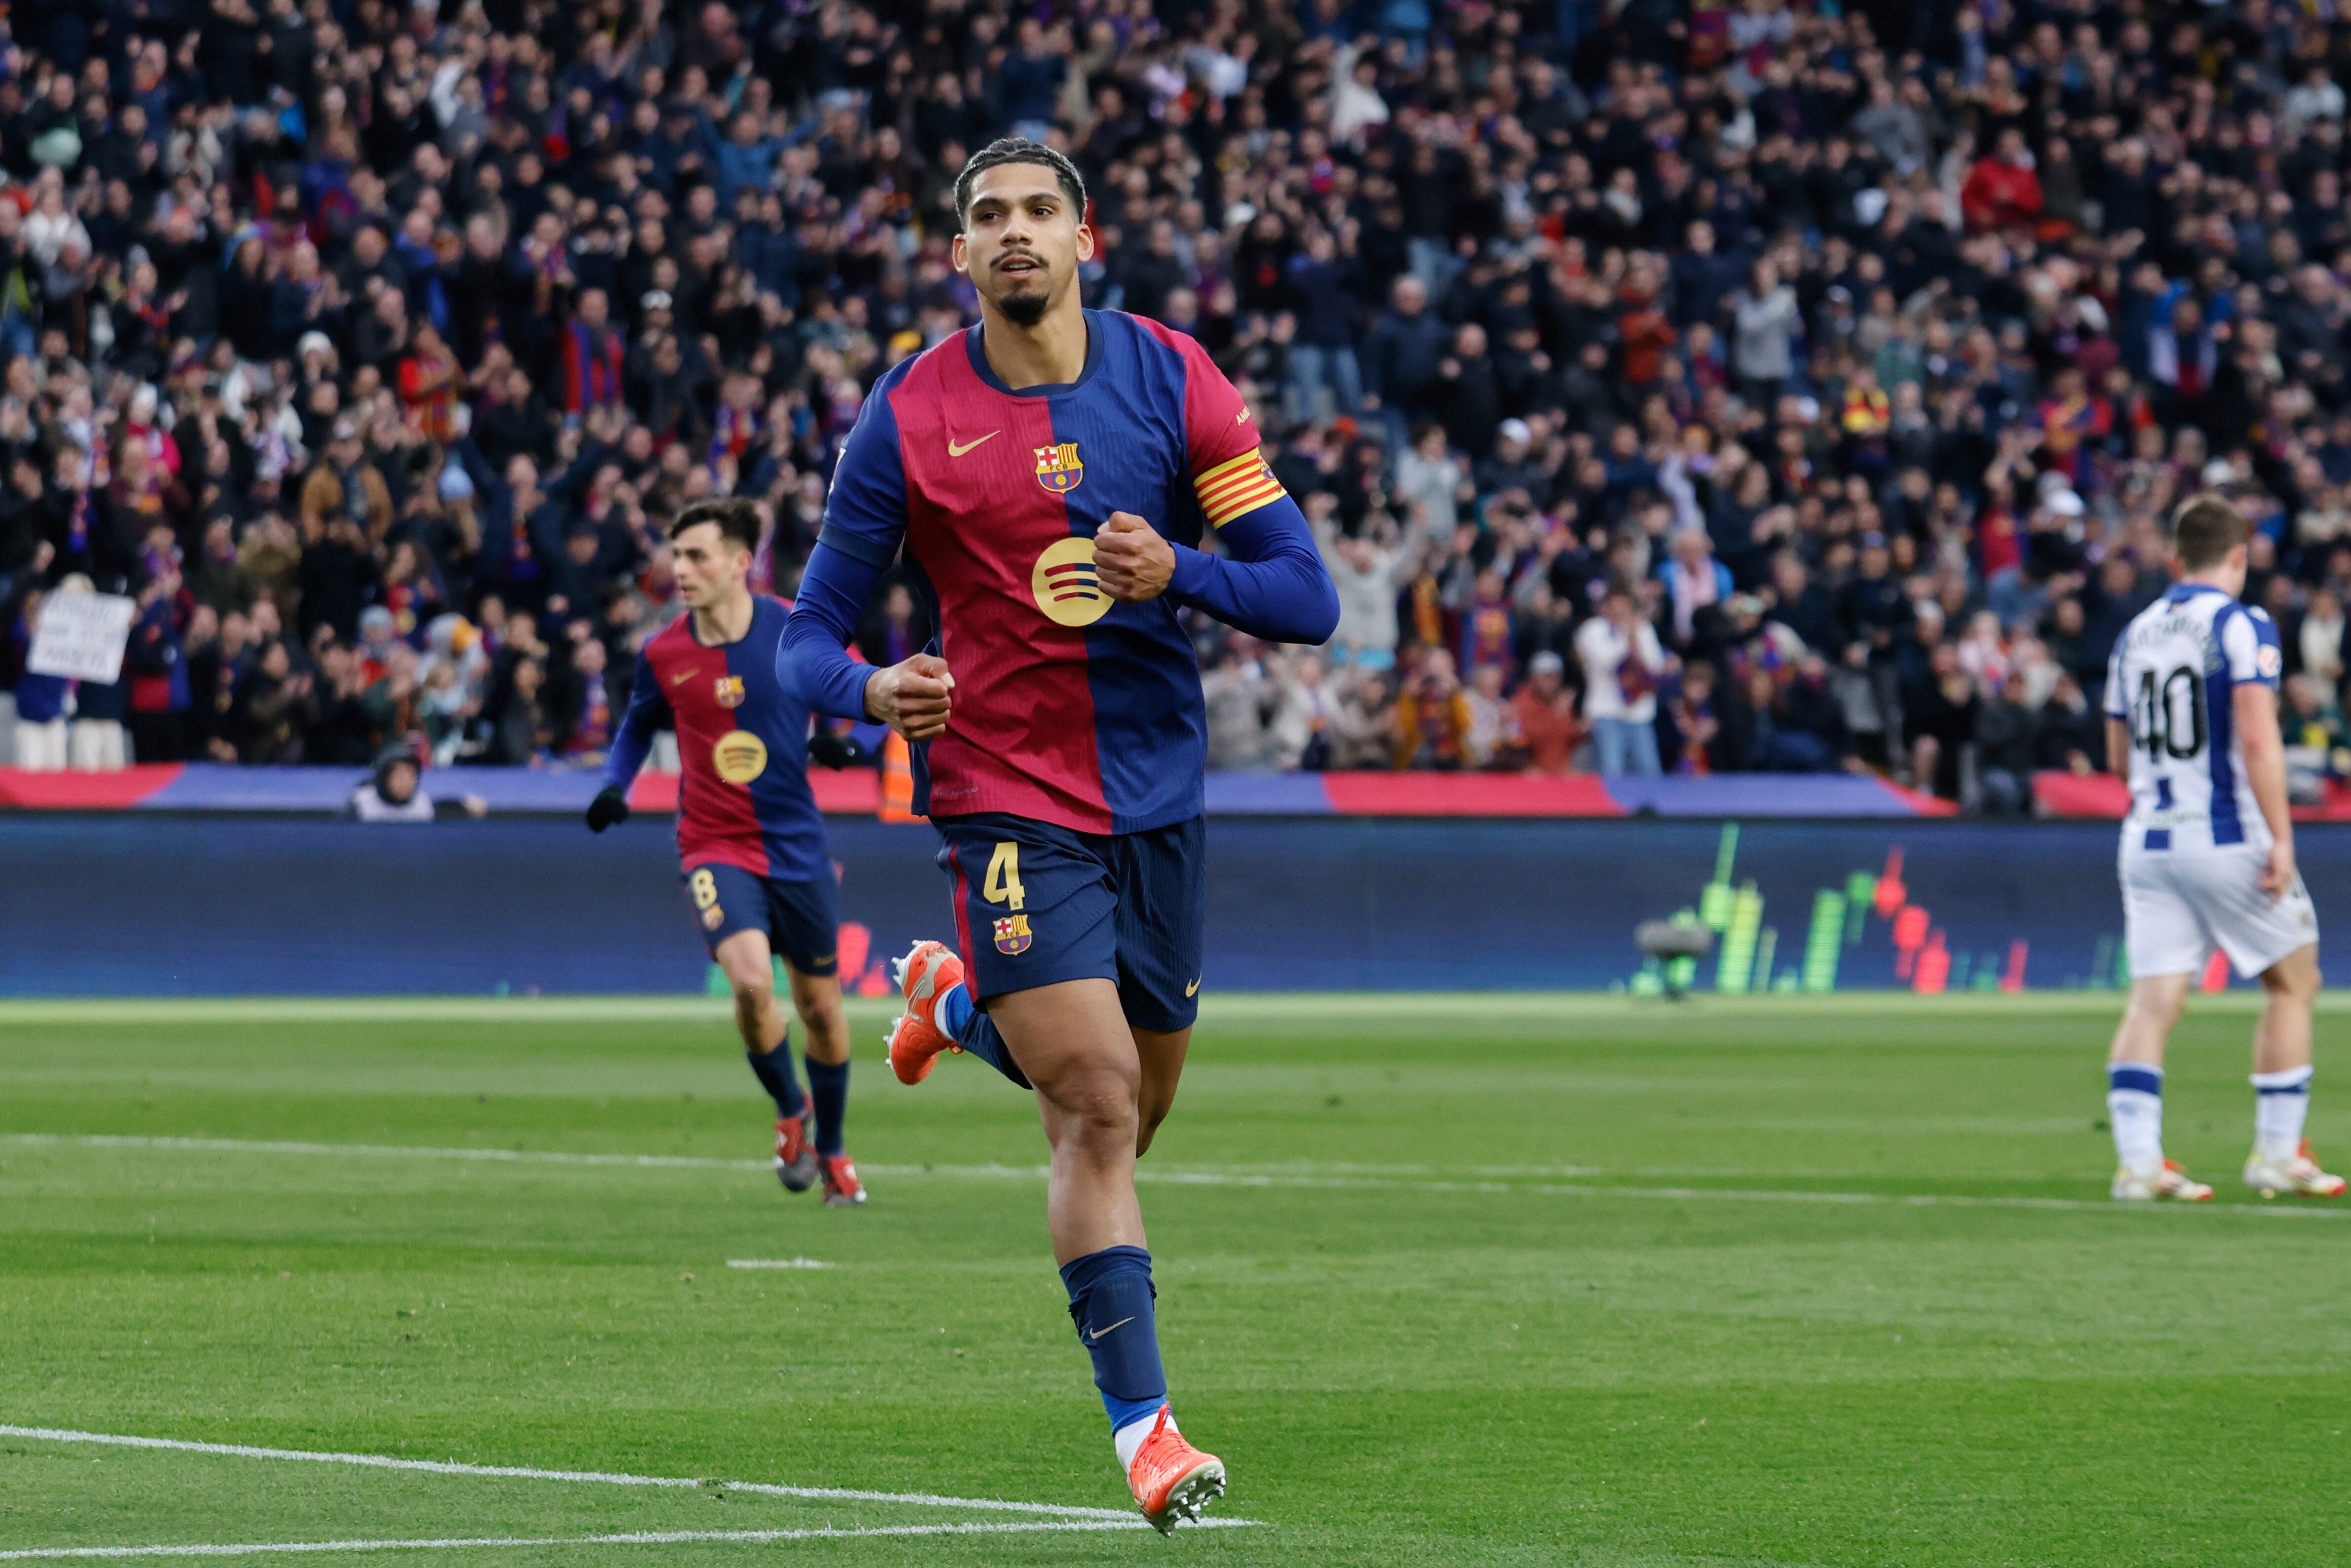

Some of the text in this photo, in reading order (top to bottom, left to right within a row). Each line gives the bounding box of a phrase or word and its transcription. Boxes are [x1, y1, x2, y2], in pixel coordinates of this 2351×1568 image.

[2134, 666, 2201, 763] 40
[692, 868, 717, 910] 8
[984, 841, 1025, 910] 4
